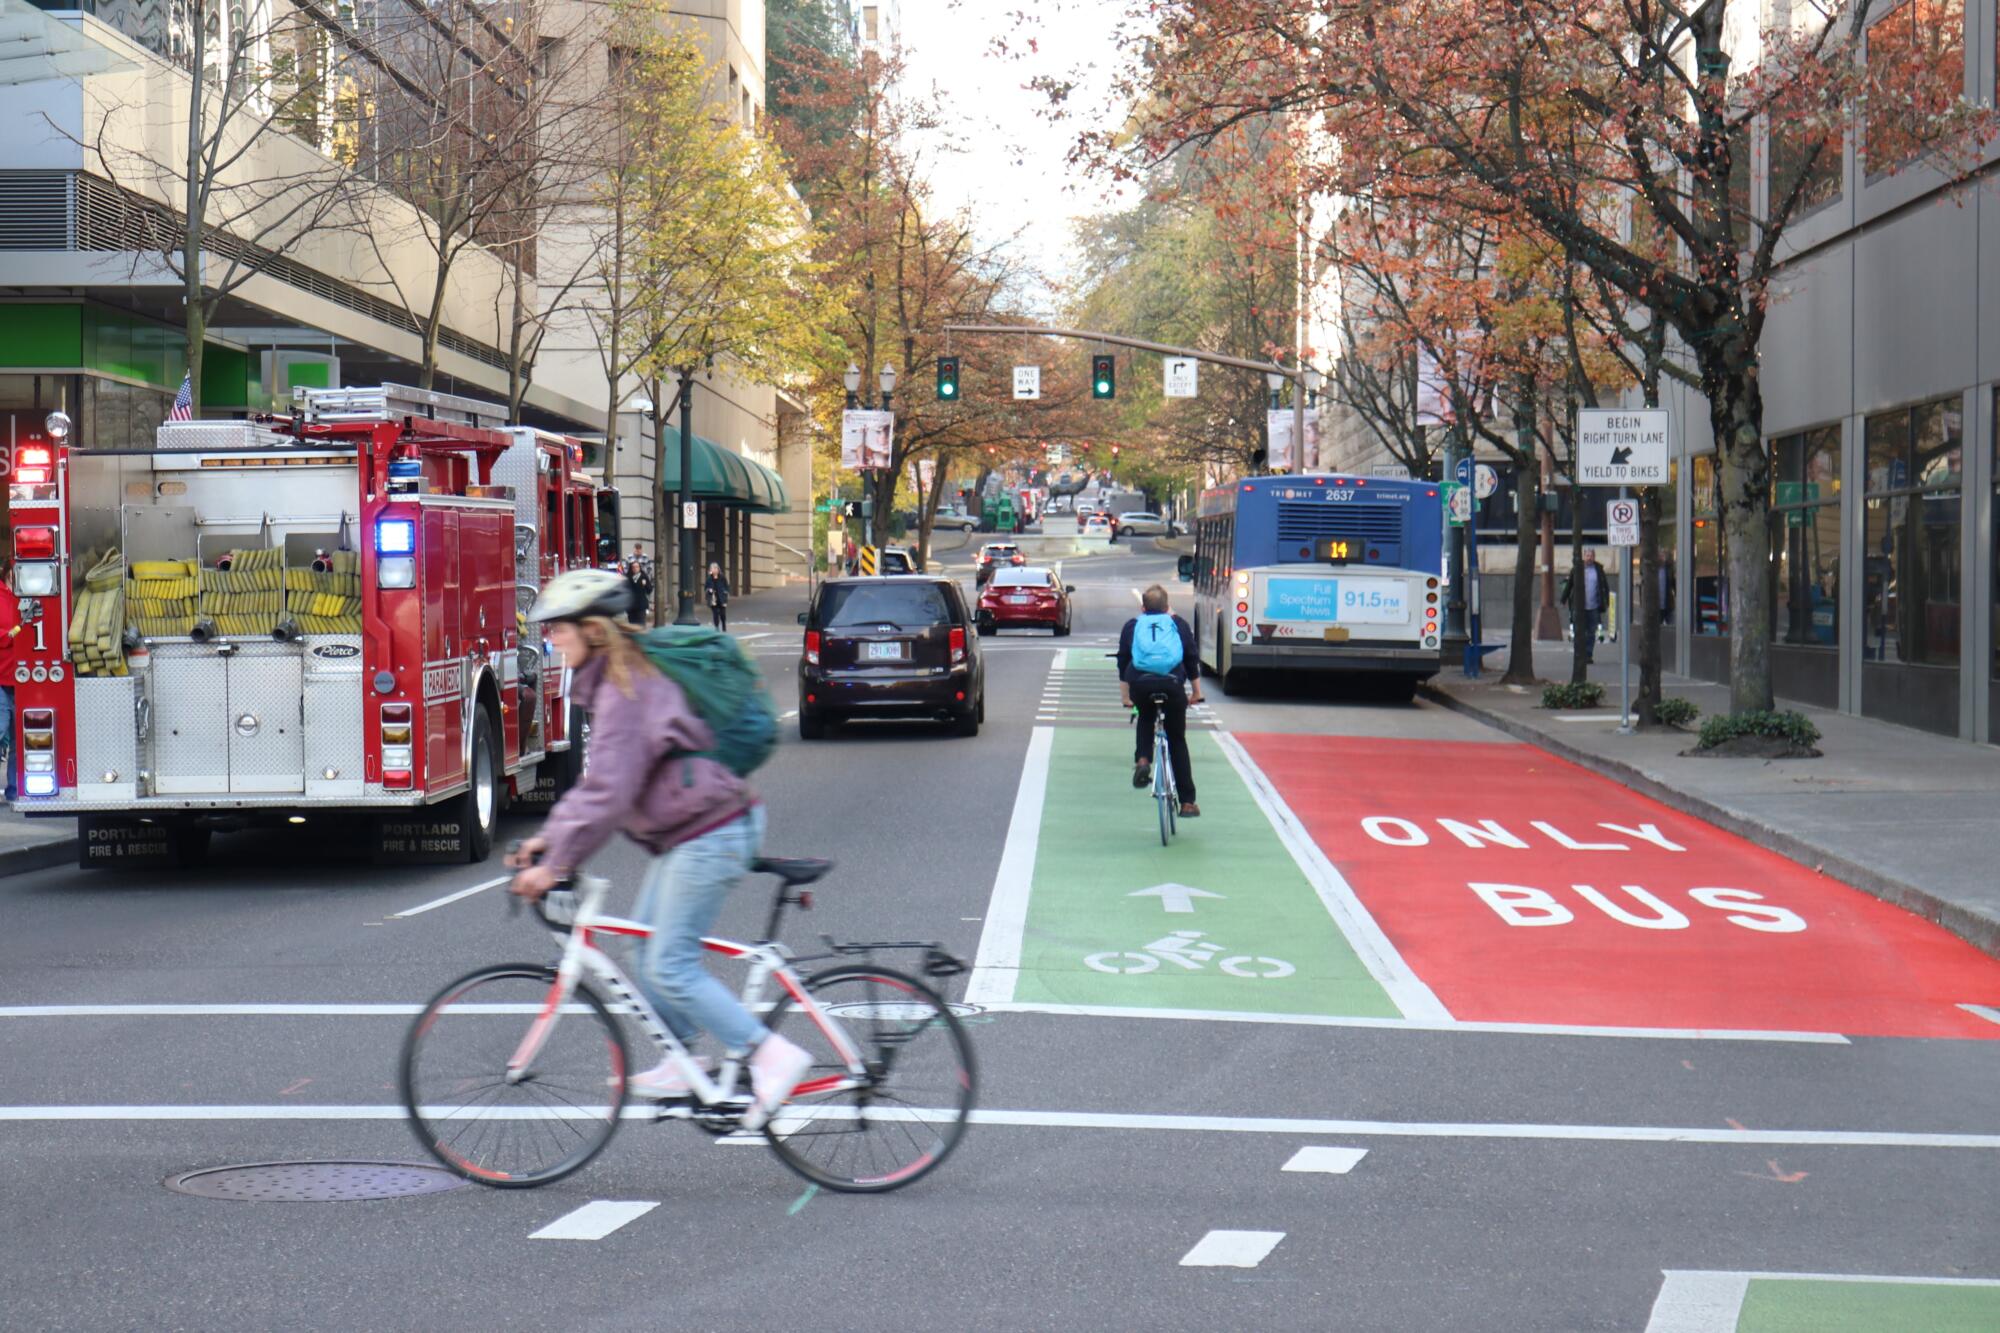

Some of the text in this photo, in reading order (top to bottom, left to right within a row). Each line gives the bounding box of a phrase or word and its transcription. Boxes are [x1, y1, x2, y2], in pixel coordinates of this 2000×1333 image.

[1018, 370, 1035, 378] ONE
[1607, 417, 1641, 429] BEGIN
[1583, 432, 1665, 444] RIGHT TURN LANE
[1584, 466, 1660, 478] YIELD TO BIKES
[1325, 489, 1355, 501] 2637
[1376, 493, 1411, 502] trimet.org
[1331, 541, 1348, 559] 14
[1313, 583, 1332, 595] Full
[1279, 593, 1331, 606] Spectrum
[1344, 591, 1400, 608] 91.5 FM
[1301, 606, 1331, 617] News
[33, 620, 48, 651] 1
[319, 646, 354, 658] Pierce
[428, 667, 461, 695] PARAMEDIC
[88, 828, 167, 840] PORTLAND
[383, 823, 461, 836] PORTLAND
[1360, 815, 1688, 852] ONLY
[89, 843, 167, 857] FIRE & RESCUE
[383, 839, 405, 852] FIRE
[420, 839, 461, 852] RESCUE
[1467, 882, 1808, 933] BUS
